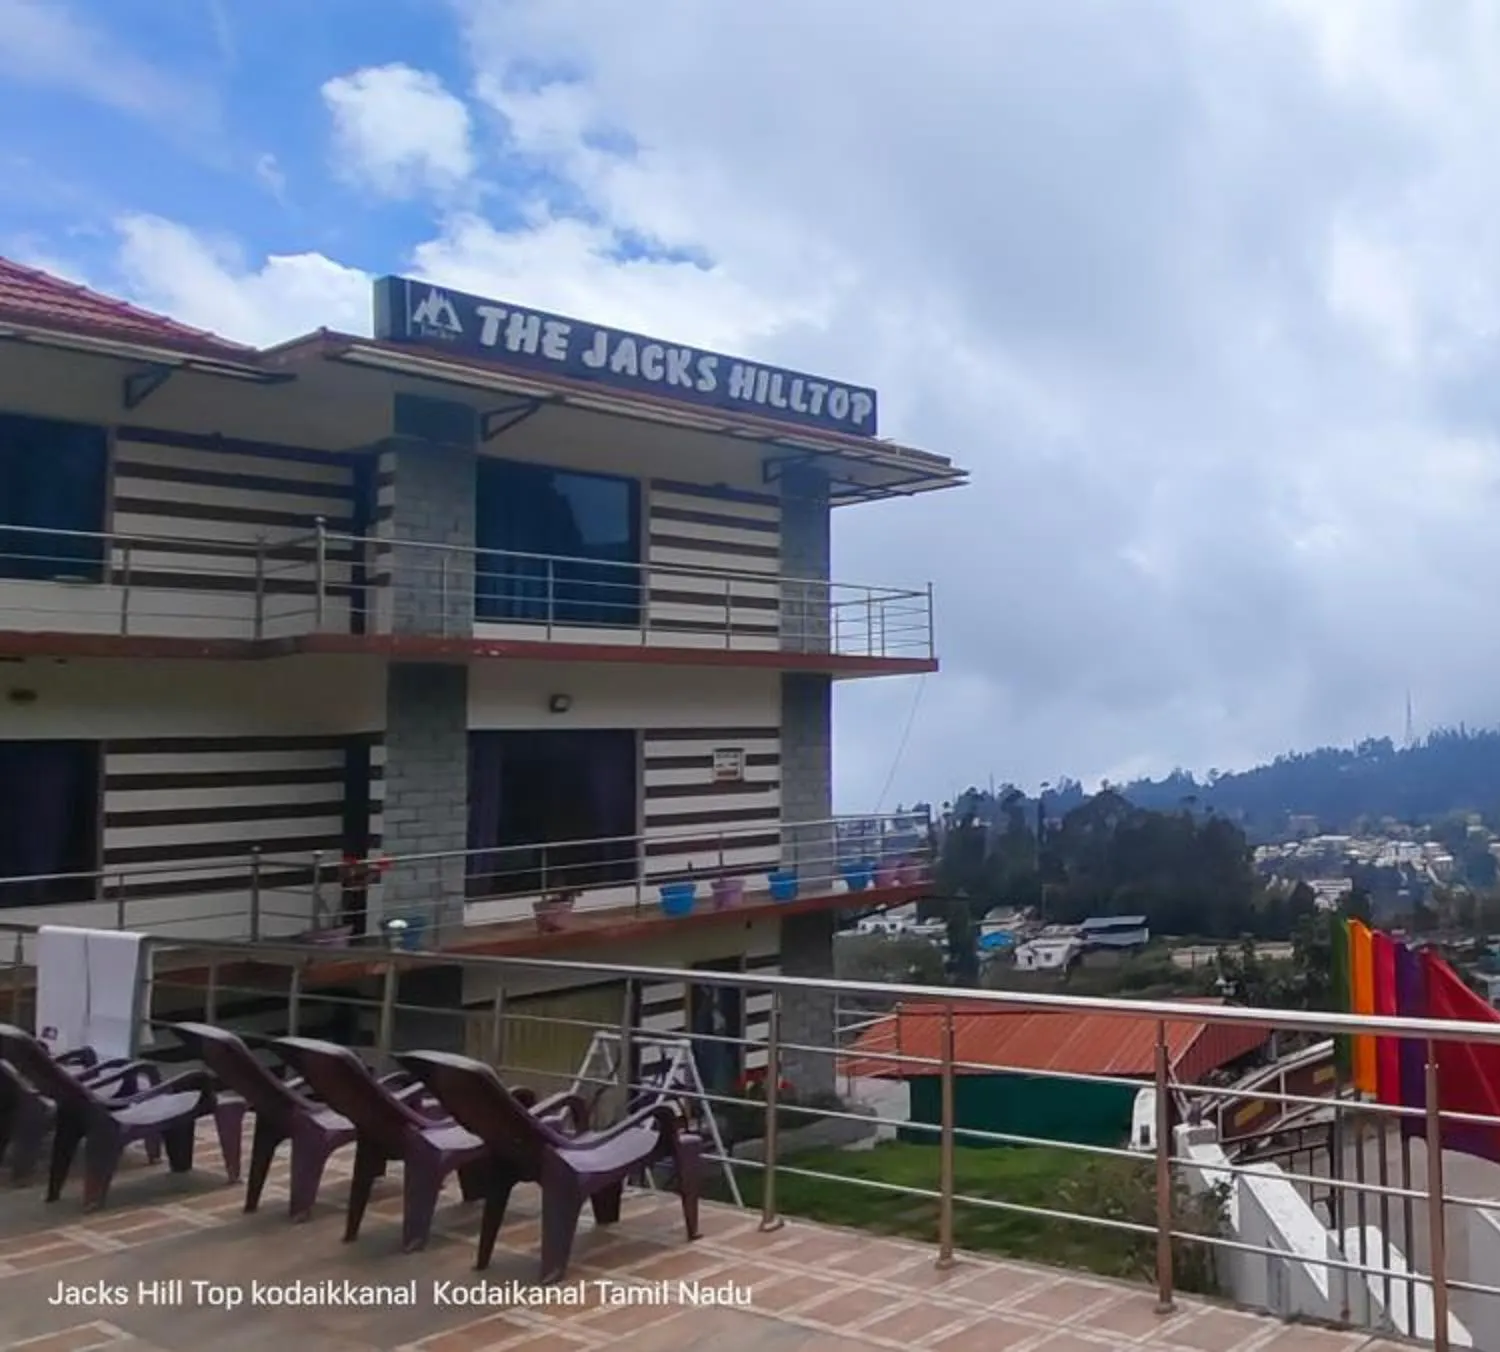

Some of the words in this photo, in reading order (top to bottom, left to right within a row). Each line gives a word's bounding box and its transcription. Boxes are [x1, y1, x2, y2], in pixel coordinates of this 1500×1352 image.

[476, 305, 571, 361] THE
[581, 330, 719, 392] JACKS
[728, 363, 873, 425] HILLTOP
